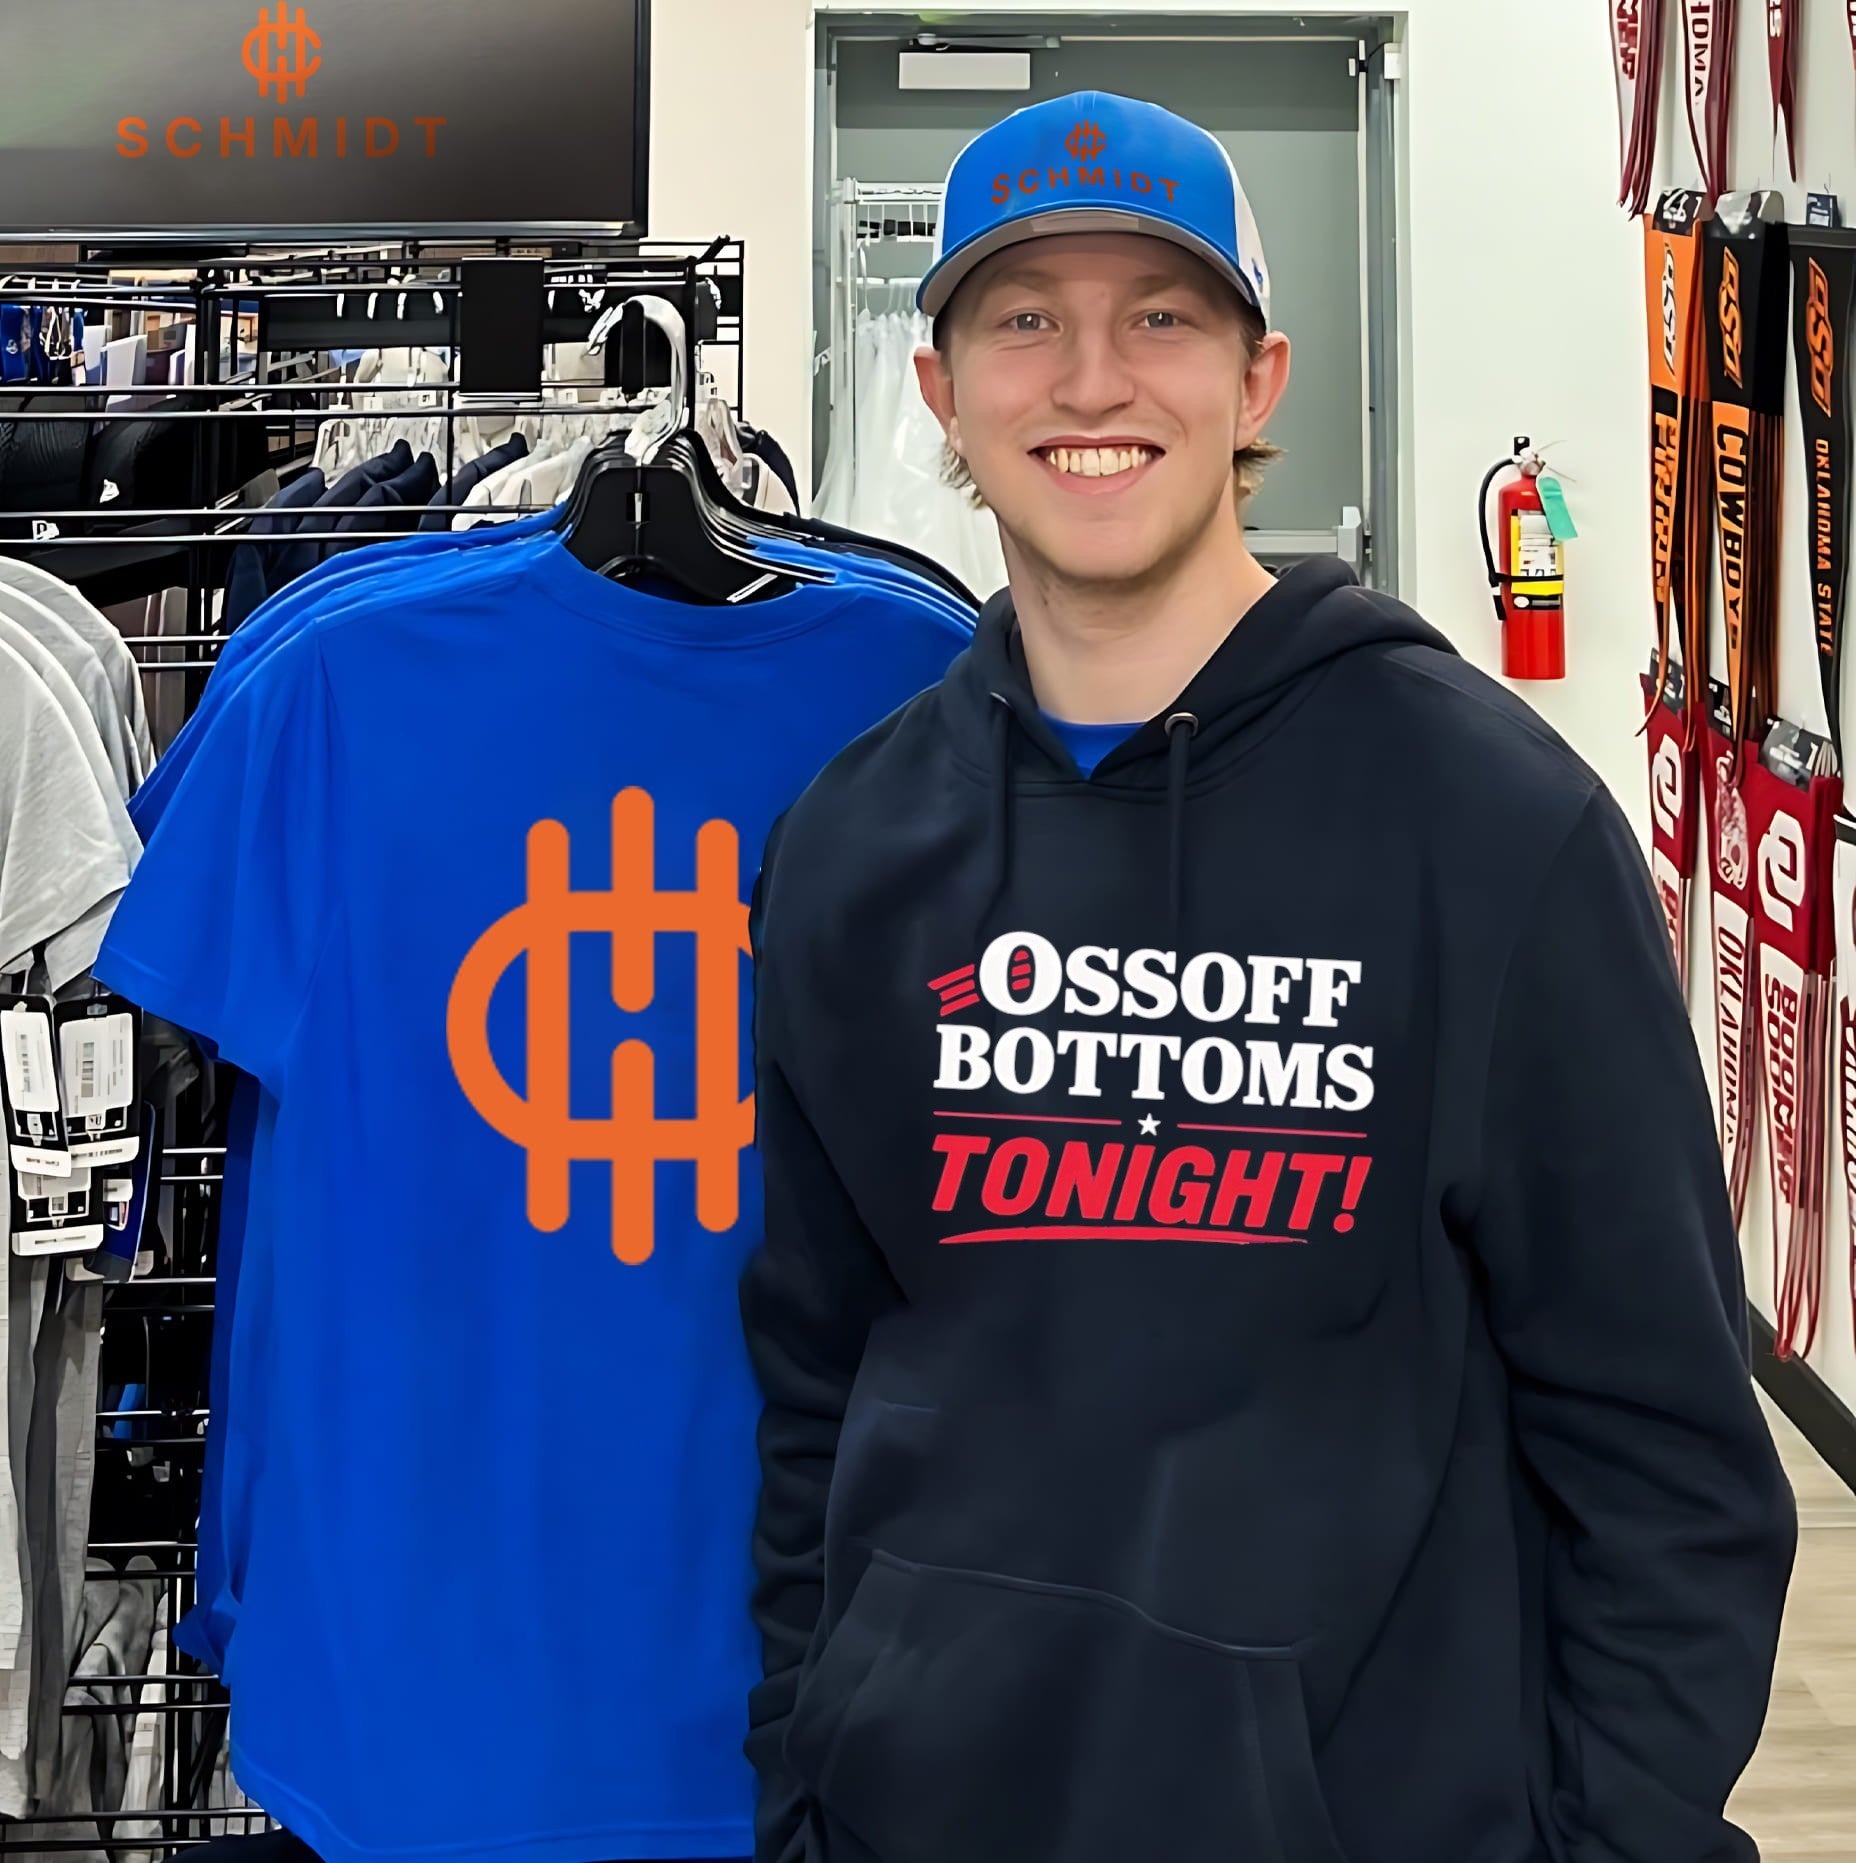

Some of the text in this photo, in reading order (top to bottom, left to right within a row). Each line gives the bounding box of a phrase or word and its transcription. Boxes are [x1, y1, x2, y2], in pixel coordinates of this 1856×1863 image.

[116, 116, 448, 159] SCHMIDT
[991, 166, 1179, 205] SCHMIDT
[1815, 438, 1832, 570] OKLAHOMA
[978, 930, 1362, 1028] OSSOFF
[933, 1023, 1375, 1112] BOTTOMS
[1718, 925, 1746, 1144] OKLAHOMA
[931, 1133, 1373, 1233] TONIGHT!
